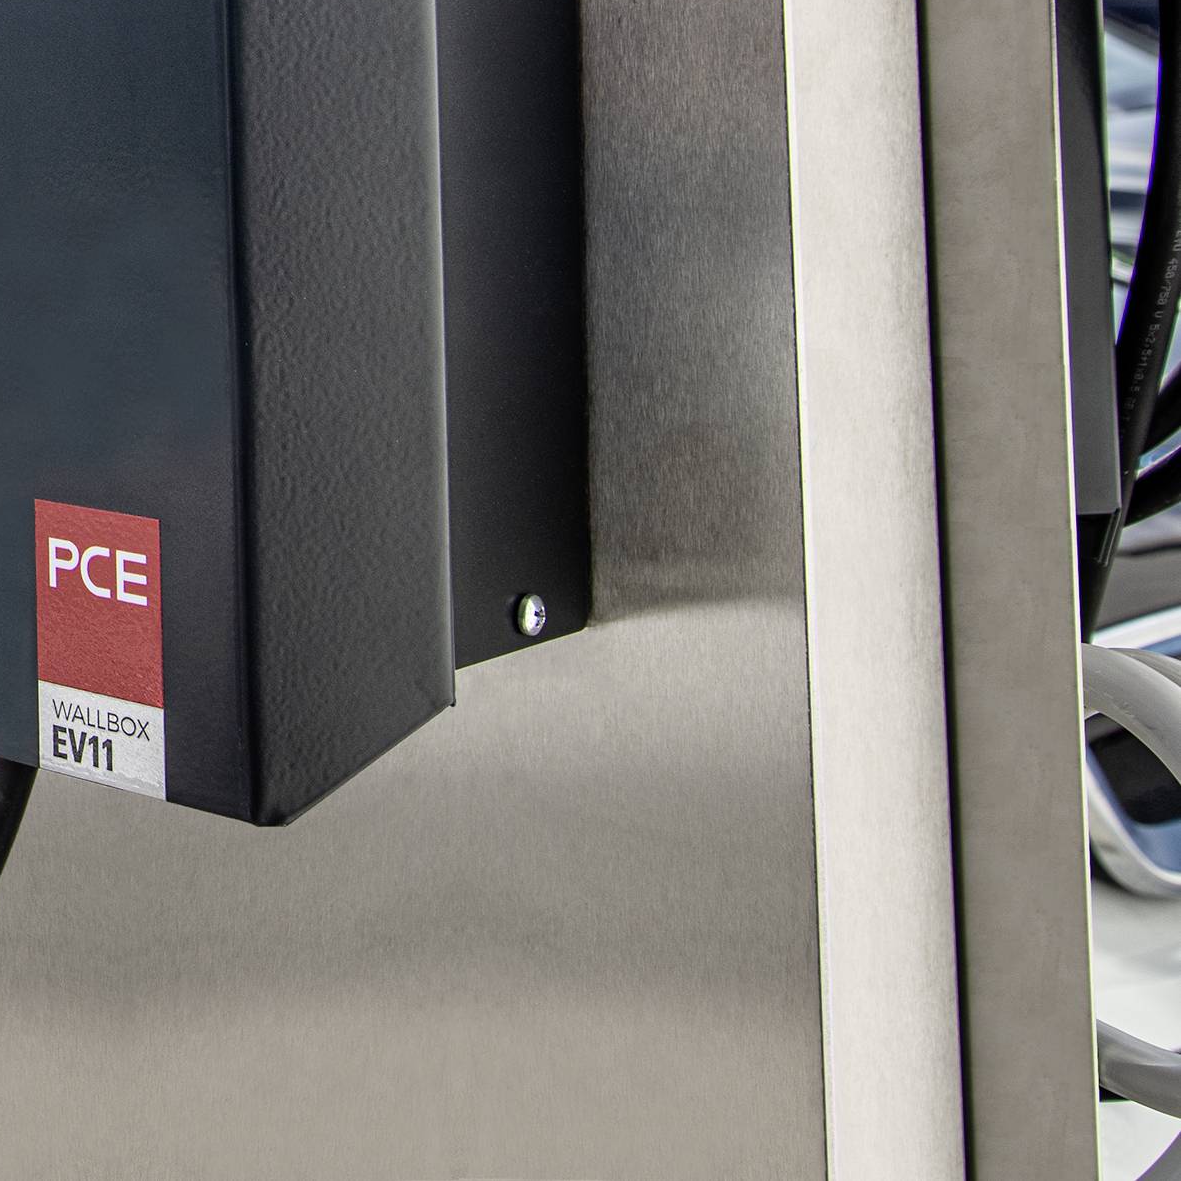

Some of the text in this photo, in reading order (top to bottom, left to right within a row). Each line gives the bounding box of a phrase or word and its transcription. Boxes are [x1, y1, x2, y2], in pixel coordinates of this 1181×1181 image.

[48, 537, 148, 606] PCE
[52, 698, 150, 741] WALLBOX
[52, 724, 113, 772] EV11
